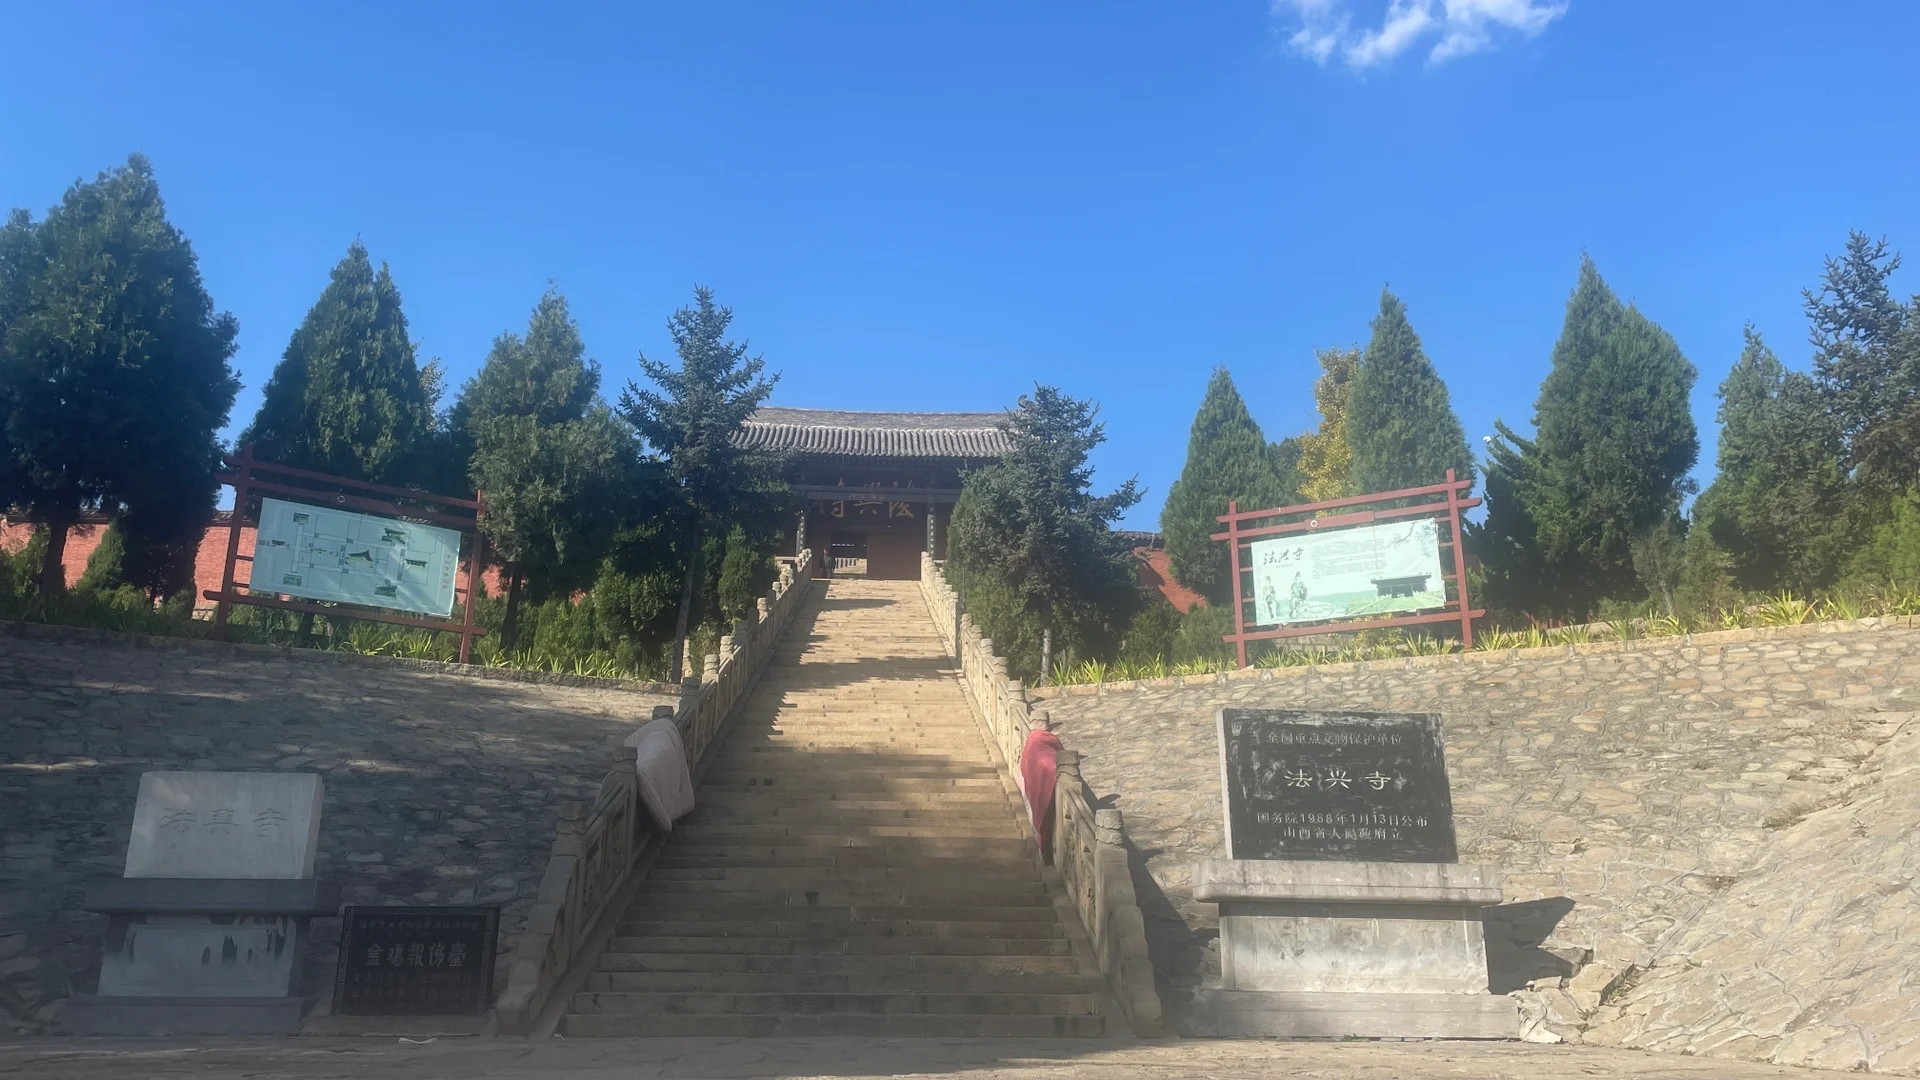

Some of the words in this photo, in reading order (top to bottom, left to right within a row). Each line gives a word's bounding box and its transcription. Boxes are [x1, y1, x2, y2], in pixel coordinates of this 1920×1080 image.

[1263, 547, 1304, 565] 法兴寺
[1267, 730, 1404, 746] 全国重点文物保护单位
[1283, 768, 1392, 791] 法兴寺
[160, 807, 290, 839] 法興寺
[1257, 811, 1430, 828] 国务院1988年1月13日公布
[1283, 826, 1404, 841] 山西省人民政府立
